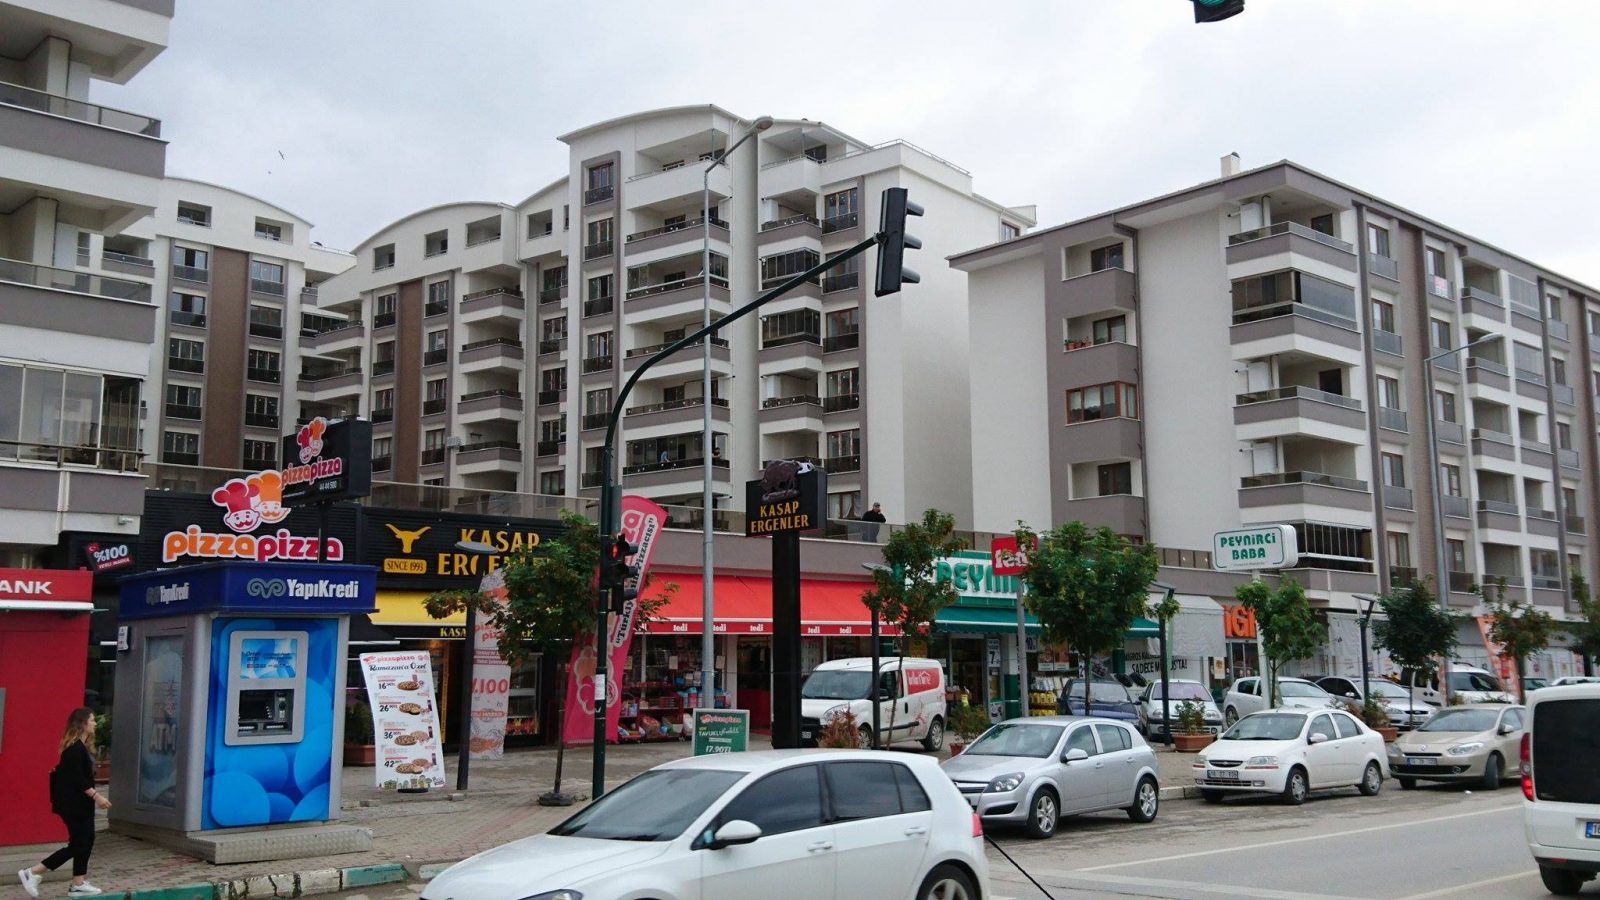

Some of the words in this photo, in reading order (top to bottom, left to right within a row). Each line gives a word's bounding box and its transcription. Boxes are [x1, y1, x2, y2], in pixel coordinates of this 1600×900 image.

[281, 456, 342, 491] pizzapizza
[760, 501, 800, 518] KASAP
[750, 515, 809, 534] ERGENLER
[163, 525, 344, 563] pizzapizza
[461, 528, 540, 553] KASAP
[93, 544, 128, 563] %100
[1232, 548, 1266, 560] BABA
[386, 560, 408, 571] SINCE
[409, 561, 424, 572] 1993
